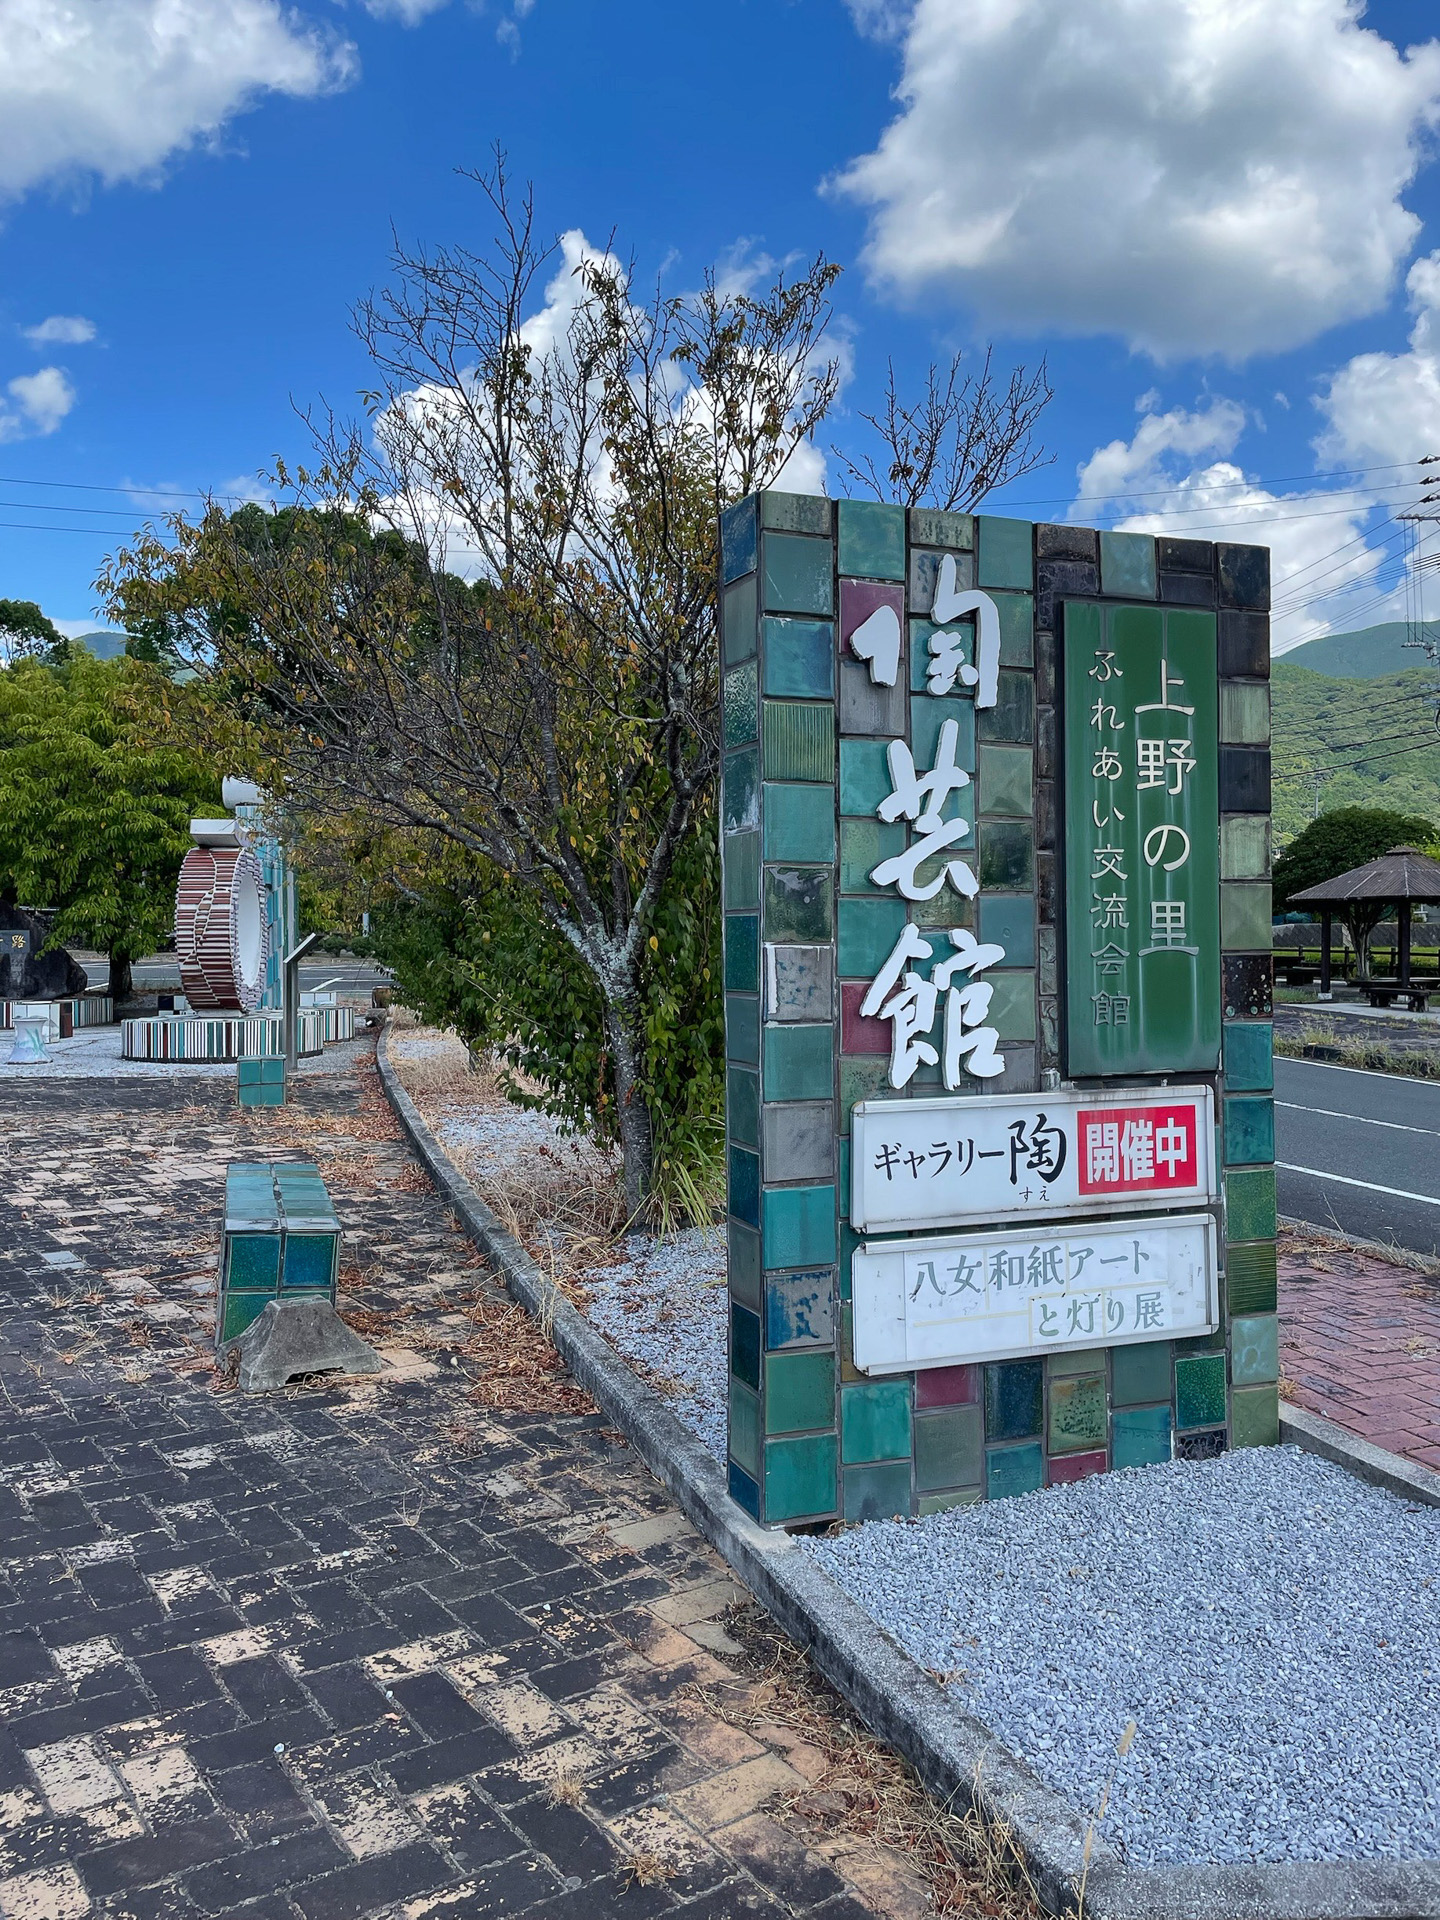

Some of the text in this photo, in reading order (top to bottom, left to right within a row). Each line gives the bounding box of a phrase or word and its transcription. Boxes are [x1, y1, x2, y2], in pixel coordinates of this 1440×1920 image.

[1088, 650, 1131, 1027] ふれあい交流会館
[1134, 658, 1200, 957] 上野の里
[1086, 1117, 1189, 1185] 開催中
[1018, 1185, 1051, 1204] すえ
[909, 1240, 1151, 1300] 八女和紙アート
[1038, 1291, 1165, 1338] と灯り展
